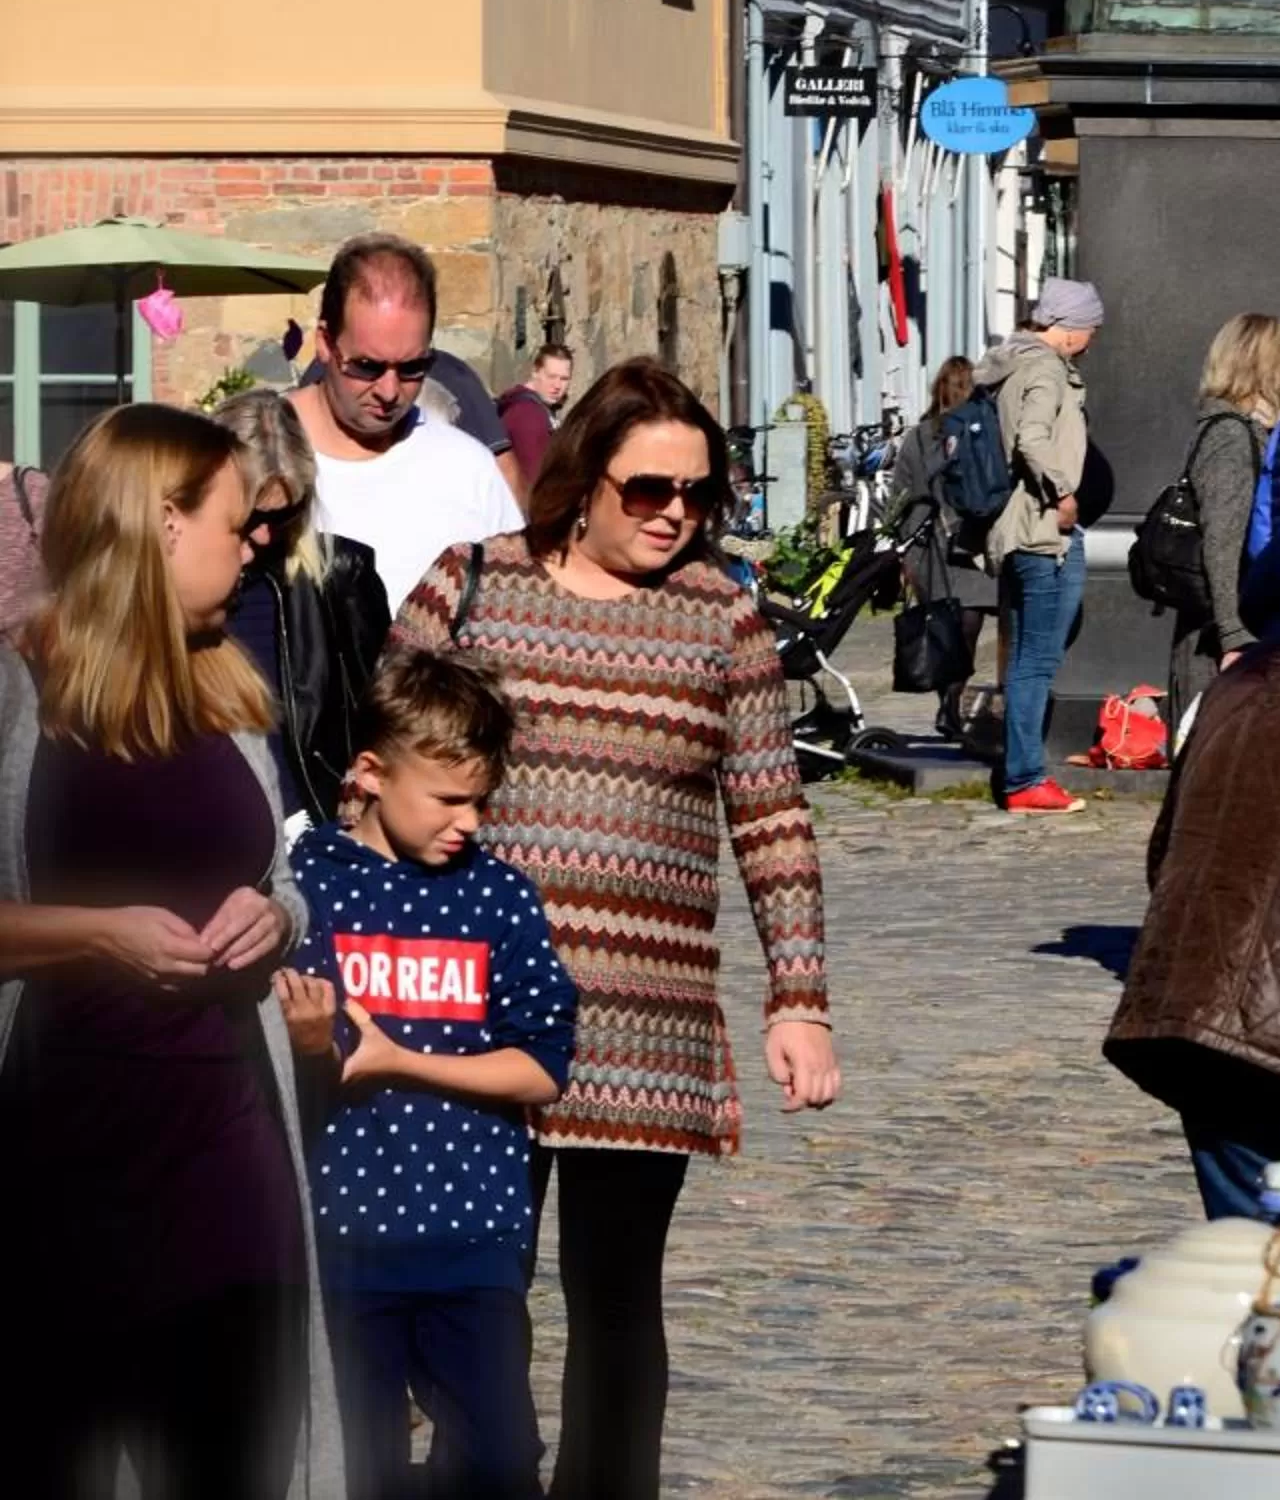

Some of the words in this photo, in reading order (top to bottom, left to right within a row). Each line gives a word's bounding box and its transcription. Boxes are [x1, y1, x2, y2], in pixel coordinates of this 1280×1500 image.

[795, 77, 865, 91] GALLERI
[931, 100, 956, 117] Blå
[336, 952, 392, 997] OR
[396, 956, 483, 1005] REAL
